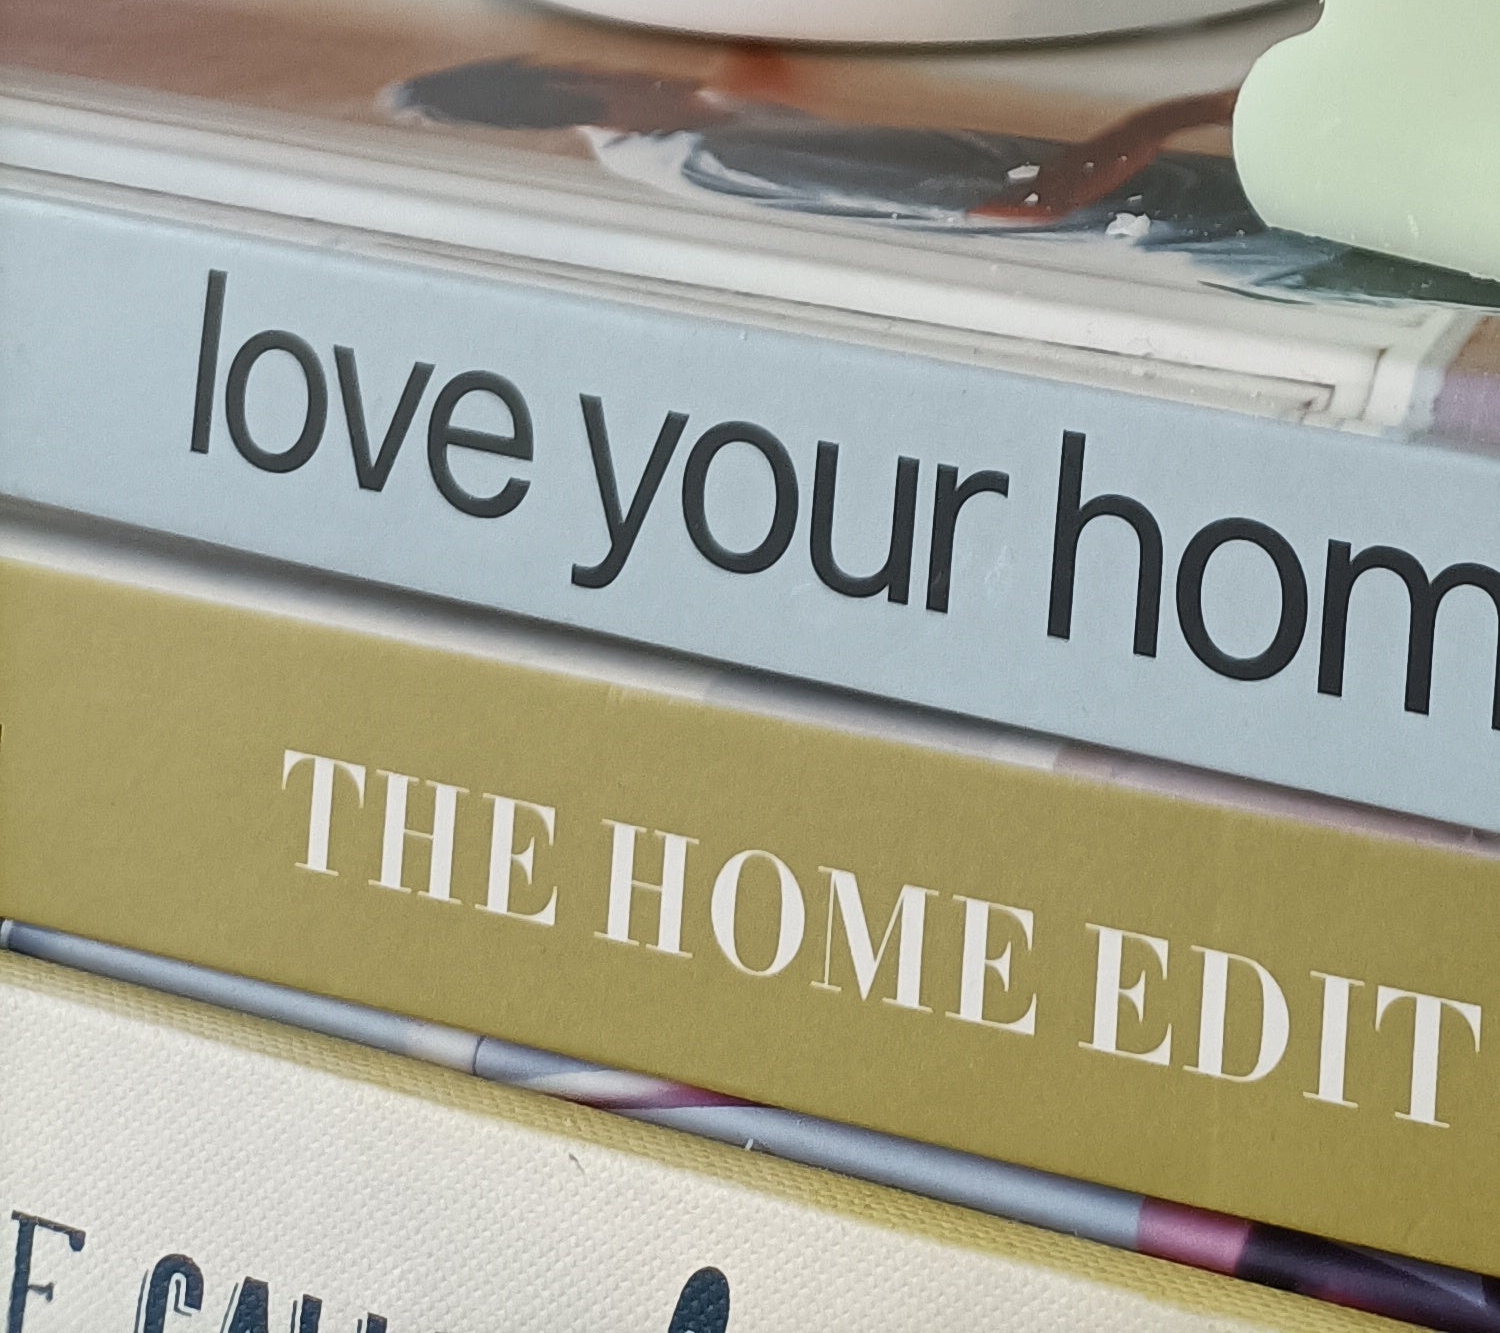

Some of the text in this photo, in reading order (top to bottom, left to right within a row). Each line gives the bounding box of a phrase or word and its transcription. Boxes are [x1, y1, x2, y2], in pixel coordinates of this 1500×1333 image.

[190, 269, 535, 519] love
[570, 392, 1010, 615] your
[281, 748, 1483, 1128] THE HOME EDIT
